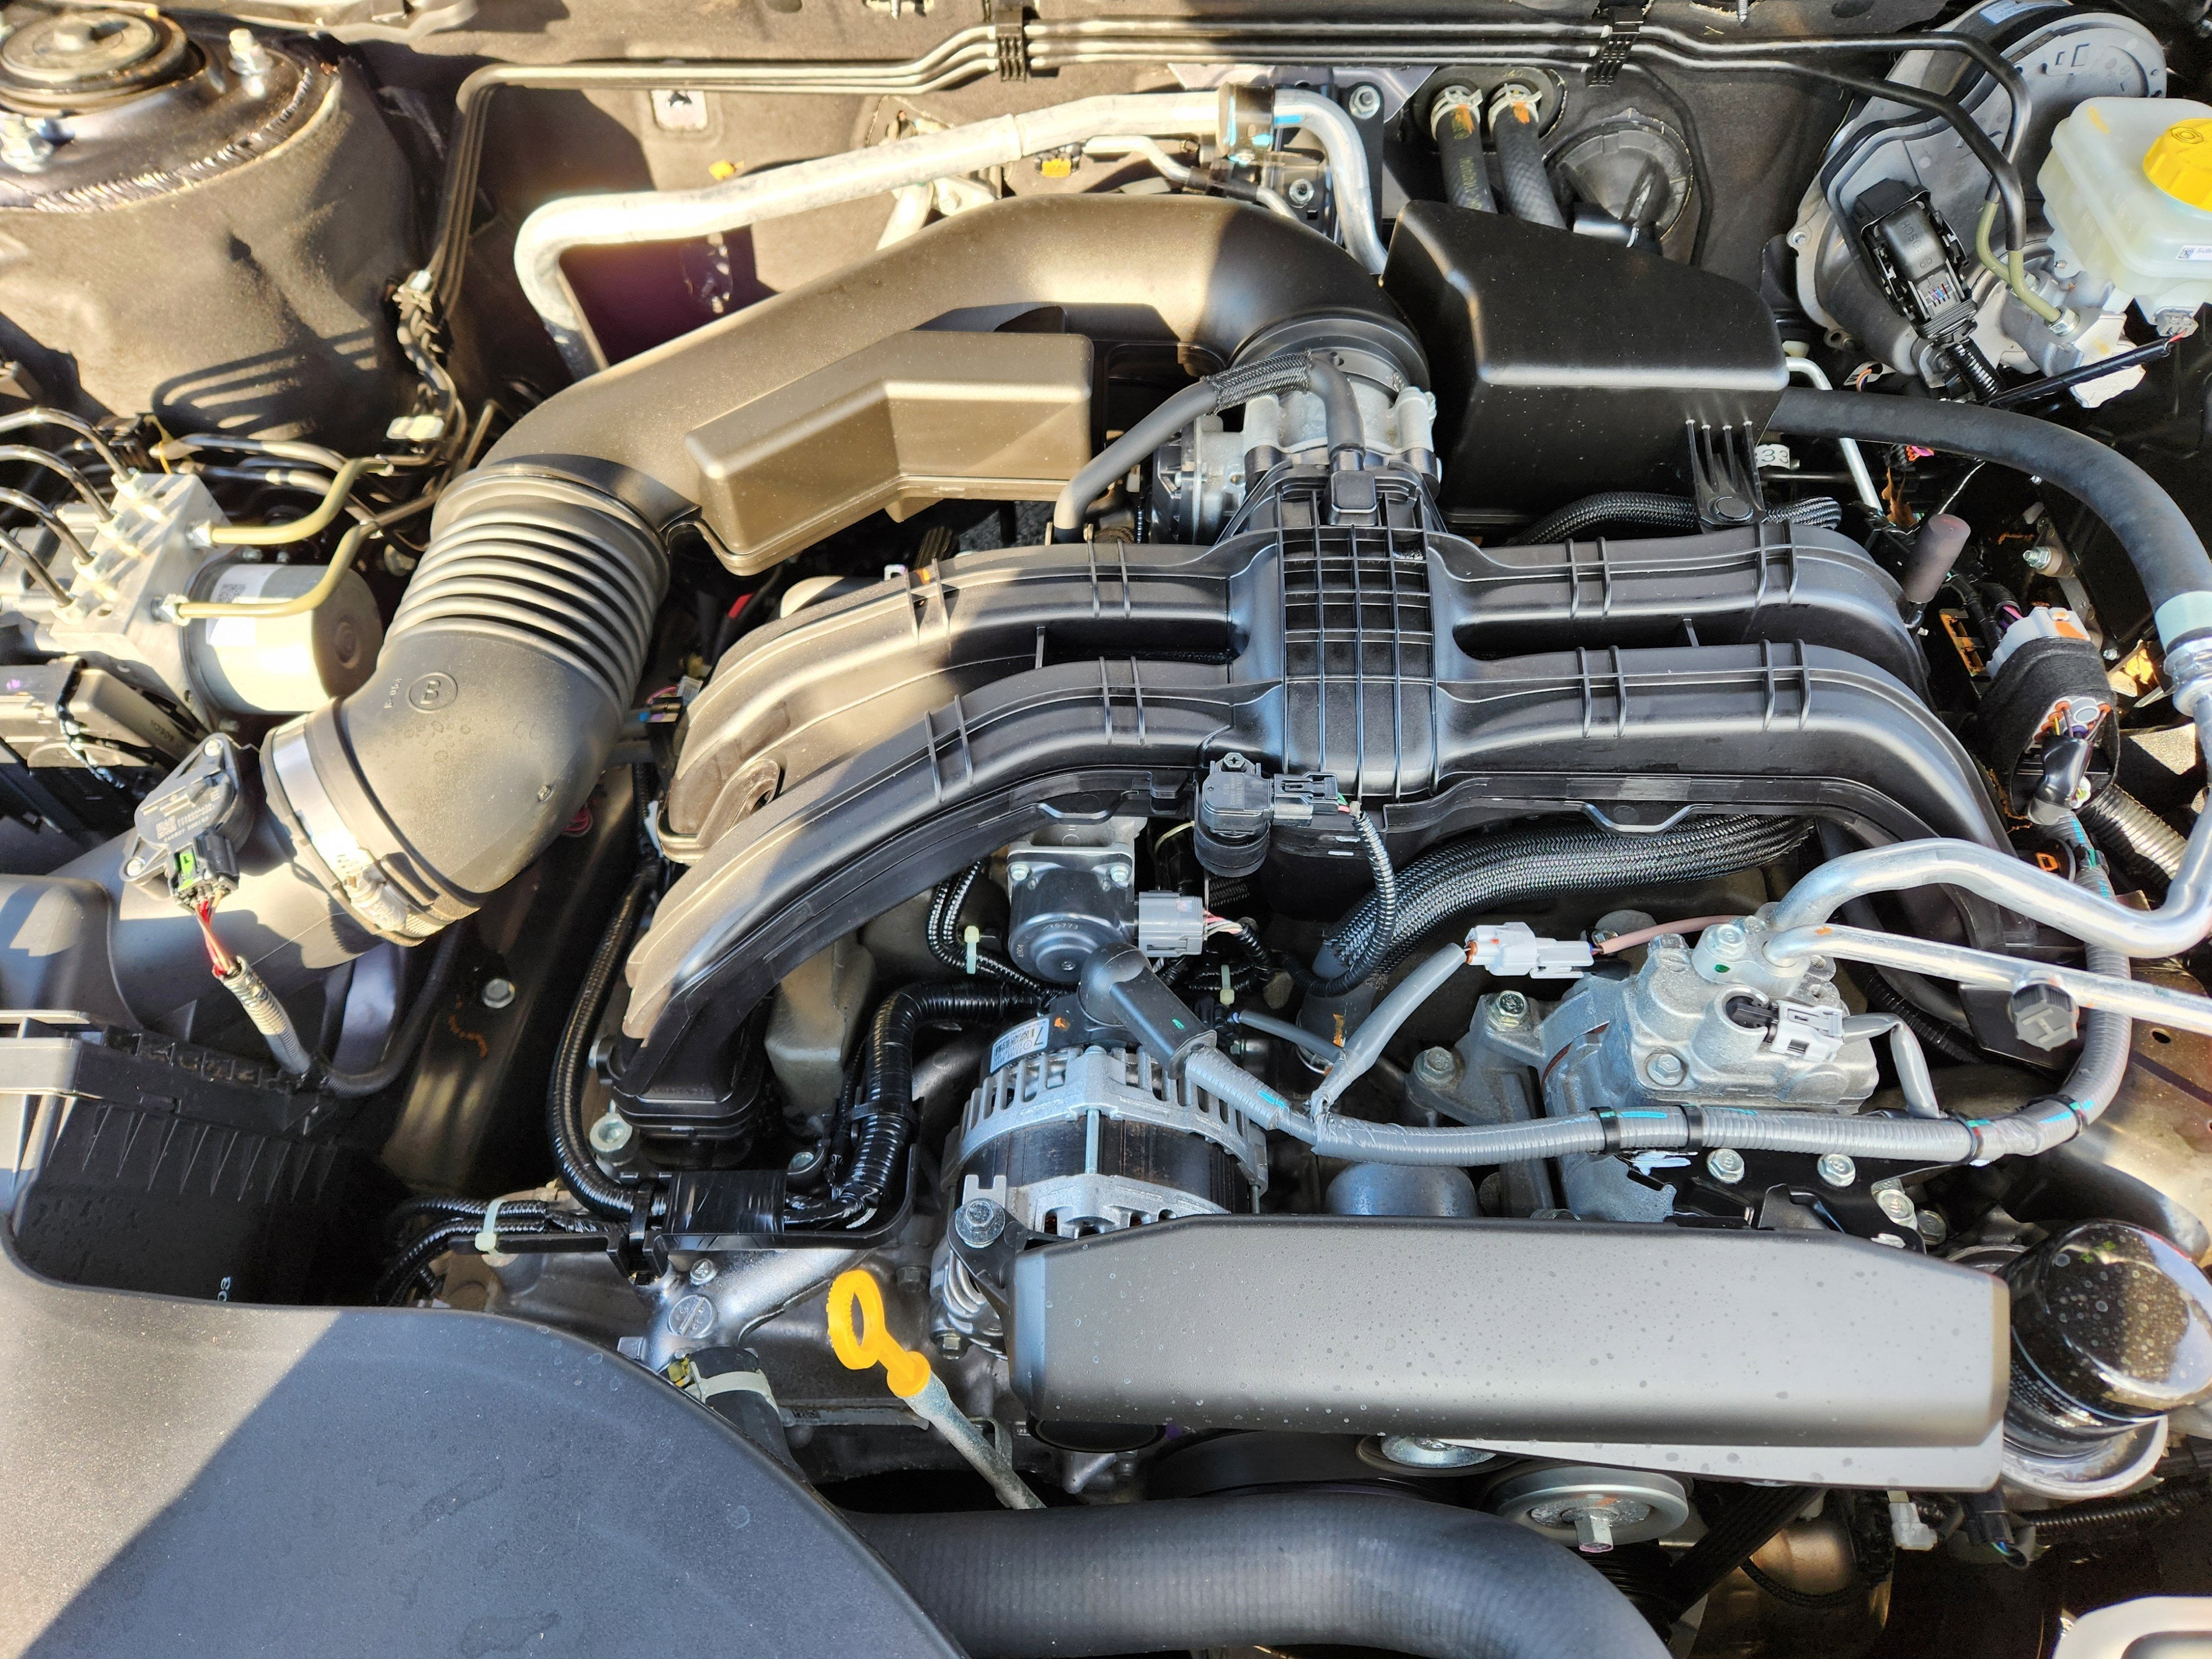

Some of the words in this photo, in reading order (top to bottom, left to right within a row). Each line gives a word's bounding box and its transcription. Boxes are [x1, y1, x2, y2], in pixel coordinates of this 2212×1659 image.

[1900, 218, 1925, 254] BOSCH
[1755, 448, 1789, 463] 33
[419, 680, 441, 705] B
[1034, 1026, 1044, 1047] 7
[2021, 1008, 2069, 1044] H
